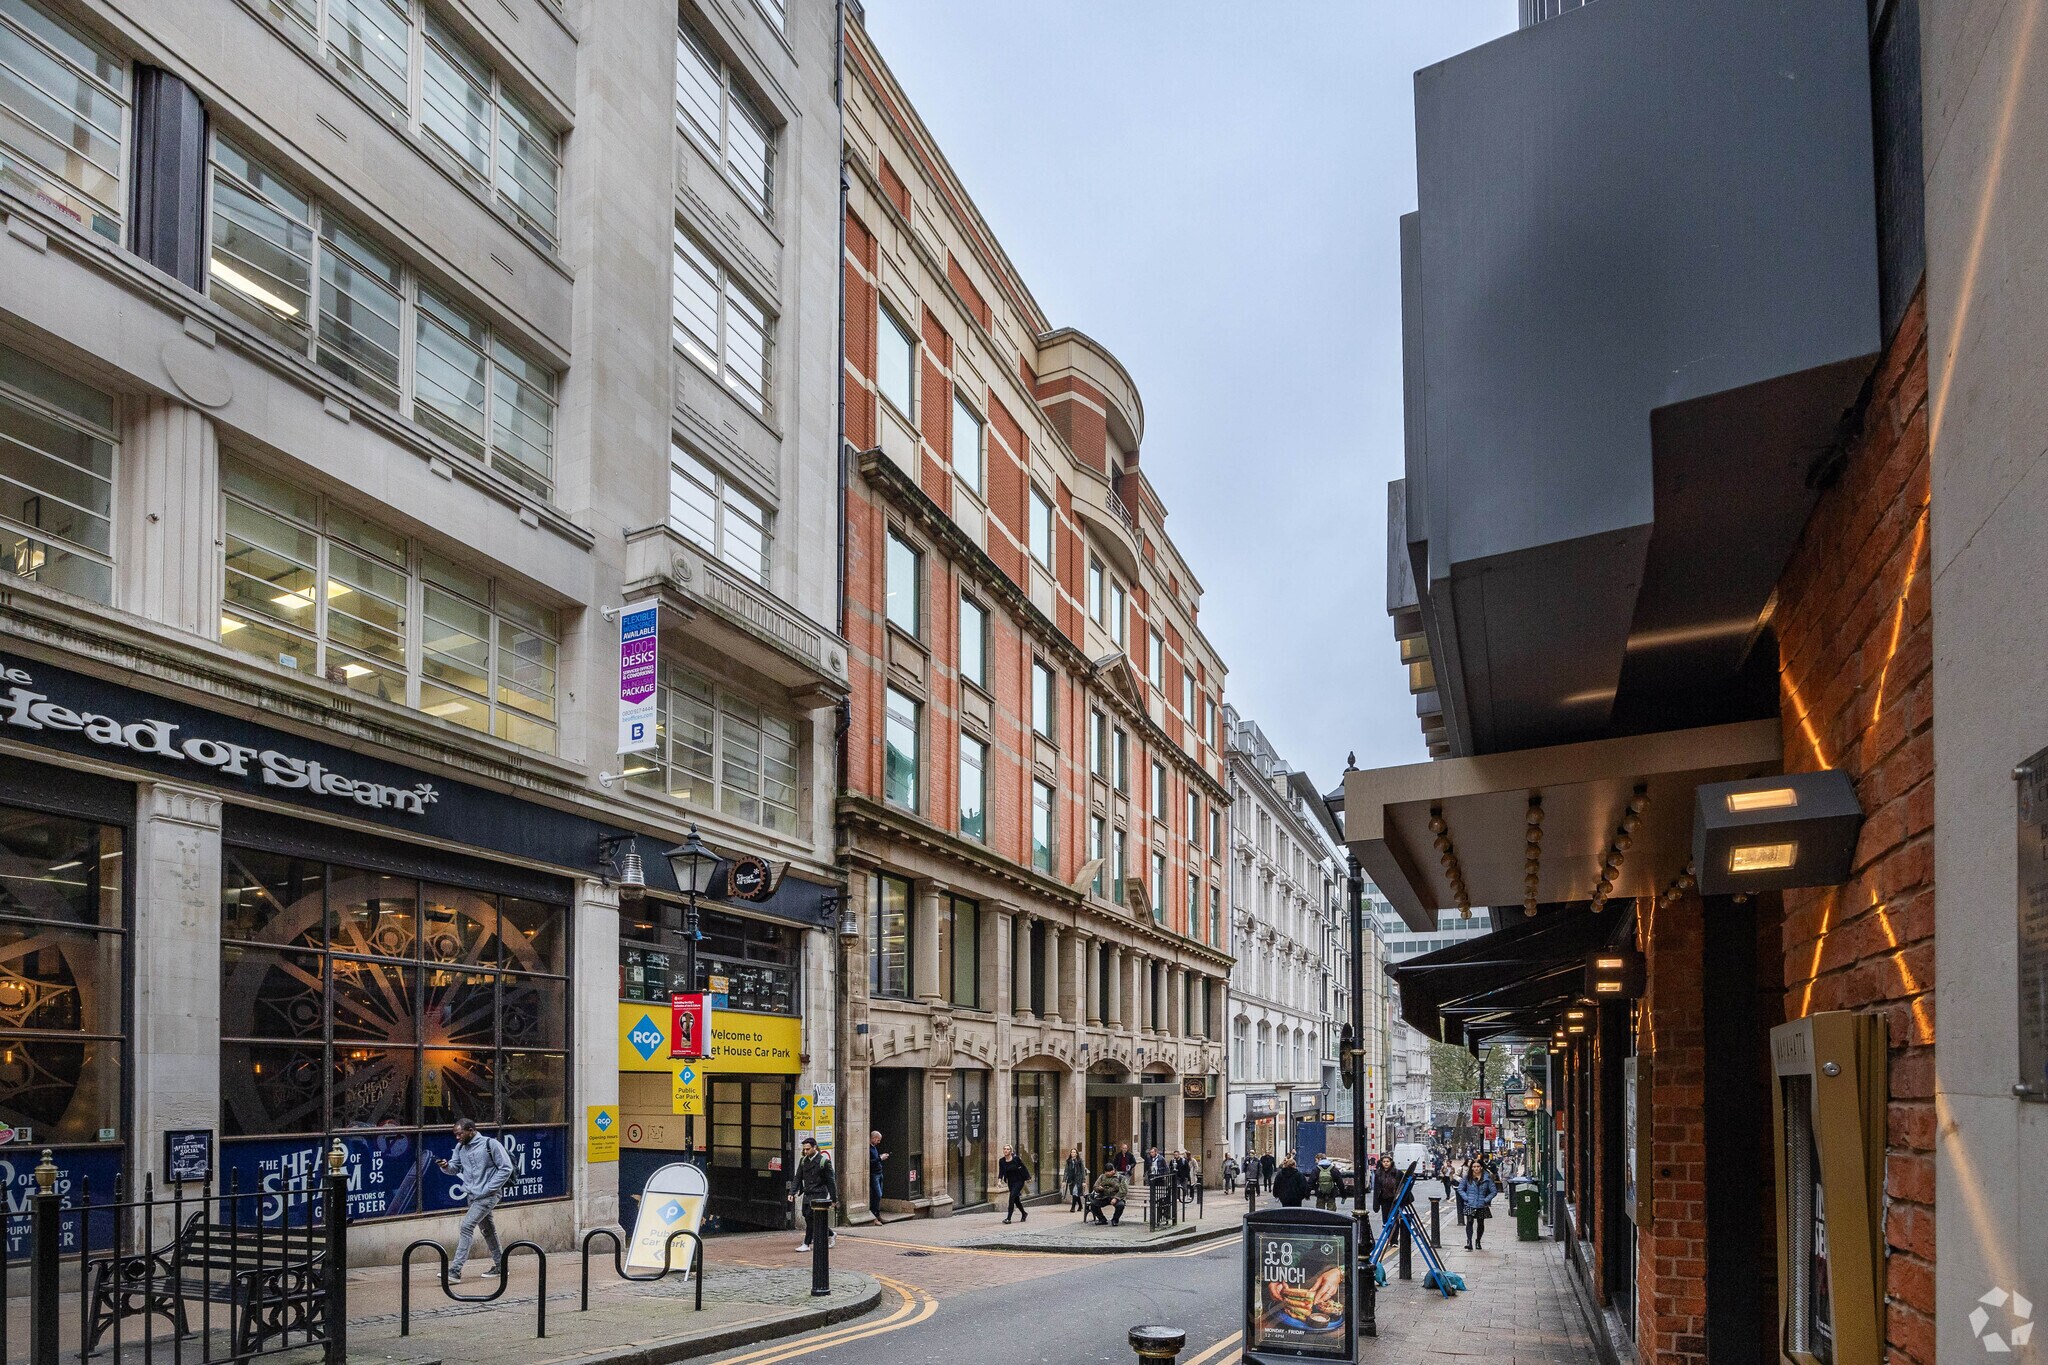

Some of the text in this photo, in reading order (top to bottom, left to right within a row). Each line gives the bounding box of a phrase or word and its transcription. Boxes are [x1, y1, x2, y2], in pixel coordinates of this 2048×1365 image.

[623, 610, 655, 625] FLEXIBLE
[623, 626, 655, 640] AVAILABLE
[623, 640, 655, 656] 1-100+
[622, 650, 655, 668] DESKS
[626, 669, 655, 680] COWORKING
[622, 683, 654, 698] PACKAGE
[0, 686, 186, 760] Head
[258, 750, 426, 815] Steam
[633, 1030, 661, 1049] RCP
[711, 1028, 763, 1042] Welcome to
[723, 1045, 752, 1057] House
[754, 1046, 770, 1057] Car
[771, 1047, 791, 1058] Park
[357, 1089, 386, 1108] STEA
[632, 1129, 638, 1138] 5
[516, 1143, 526, 1152] OF
[532, 1148, 542, 1159] 19
[259, 1159, 279, 1171] THE
[350, 1153, 362, 1164] OF
[371, 1158, 384, 1171] 19
[530, 1159, 543, 1170] 95
[369, 1171, 384, 1184] 95
[346, 1191, 386, 1203] URVEYORS OF
[500, 1184, 544, 1198] EAT BEER
[358, 1200, 387, 1214] BEER
[62, 1221, 74, 1231] OF
[650, 1229, 682, 1239] Pub
[641, 1237, 686, 1249] Car ark
[1264, 1241, 1293, 1266] £8
[1264, 1265, 1306, 1284] LUNCH
